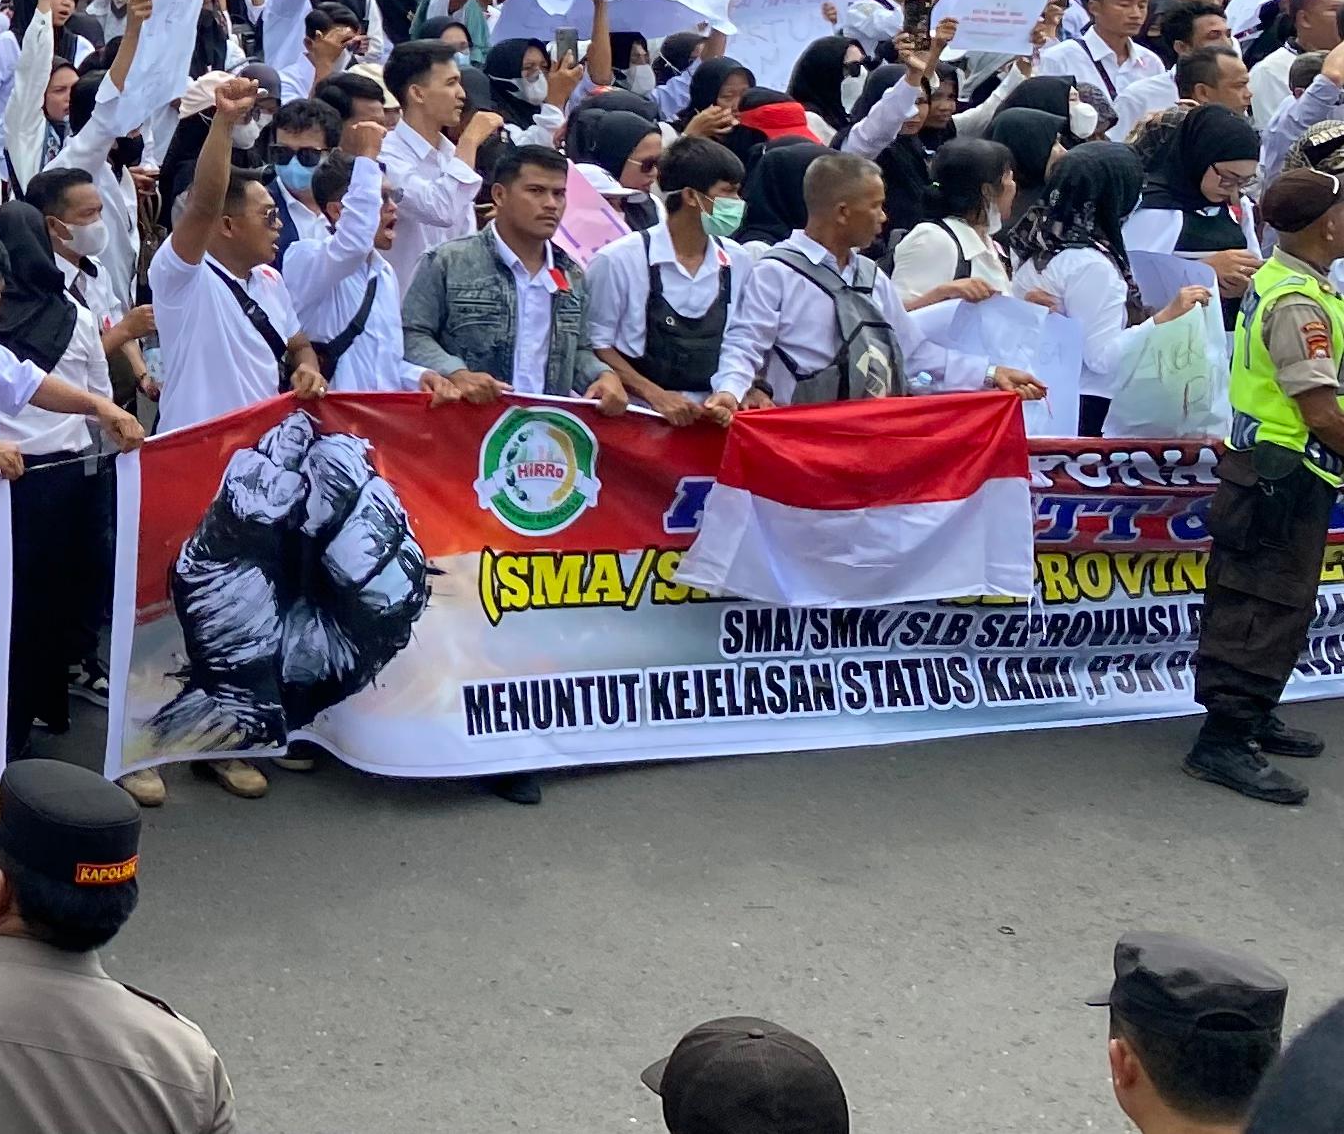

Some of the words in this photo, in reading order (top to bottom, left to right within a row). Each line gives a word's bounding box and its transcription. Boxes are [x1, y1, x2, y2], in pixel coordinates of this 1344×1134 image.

[482, 547, 694, 624] (SMA/S
[722, 606, 972, 655] SMA/SMK/SLB
[975, 604, 1180, 649] SEPROVINSI
[463, 676, 640, 736] MENUNTUT
[650, 665, 836, 721] KEJELASAN
[843, 656, 975, 710] STATUS
[977, 655, 1077, 701] KAMI
